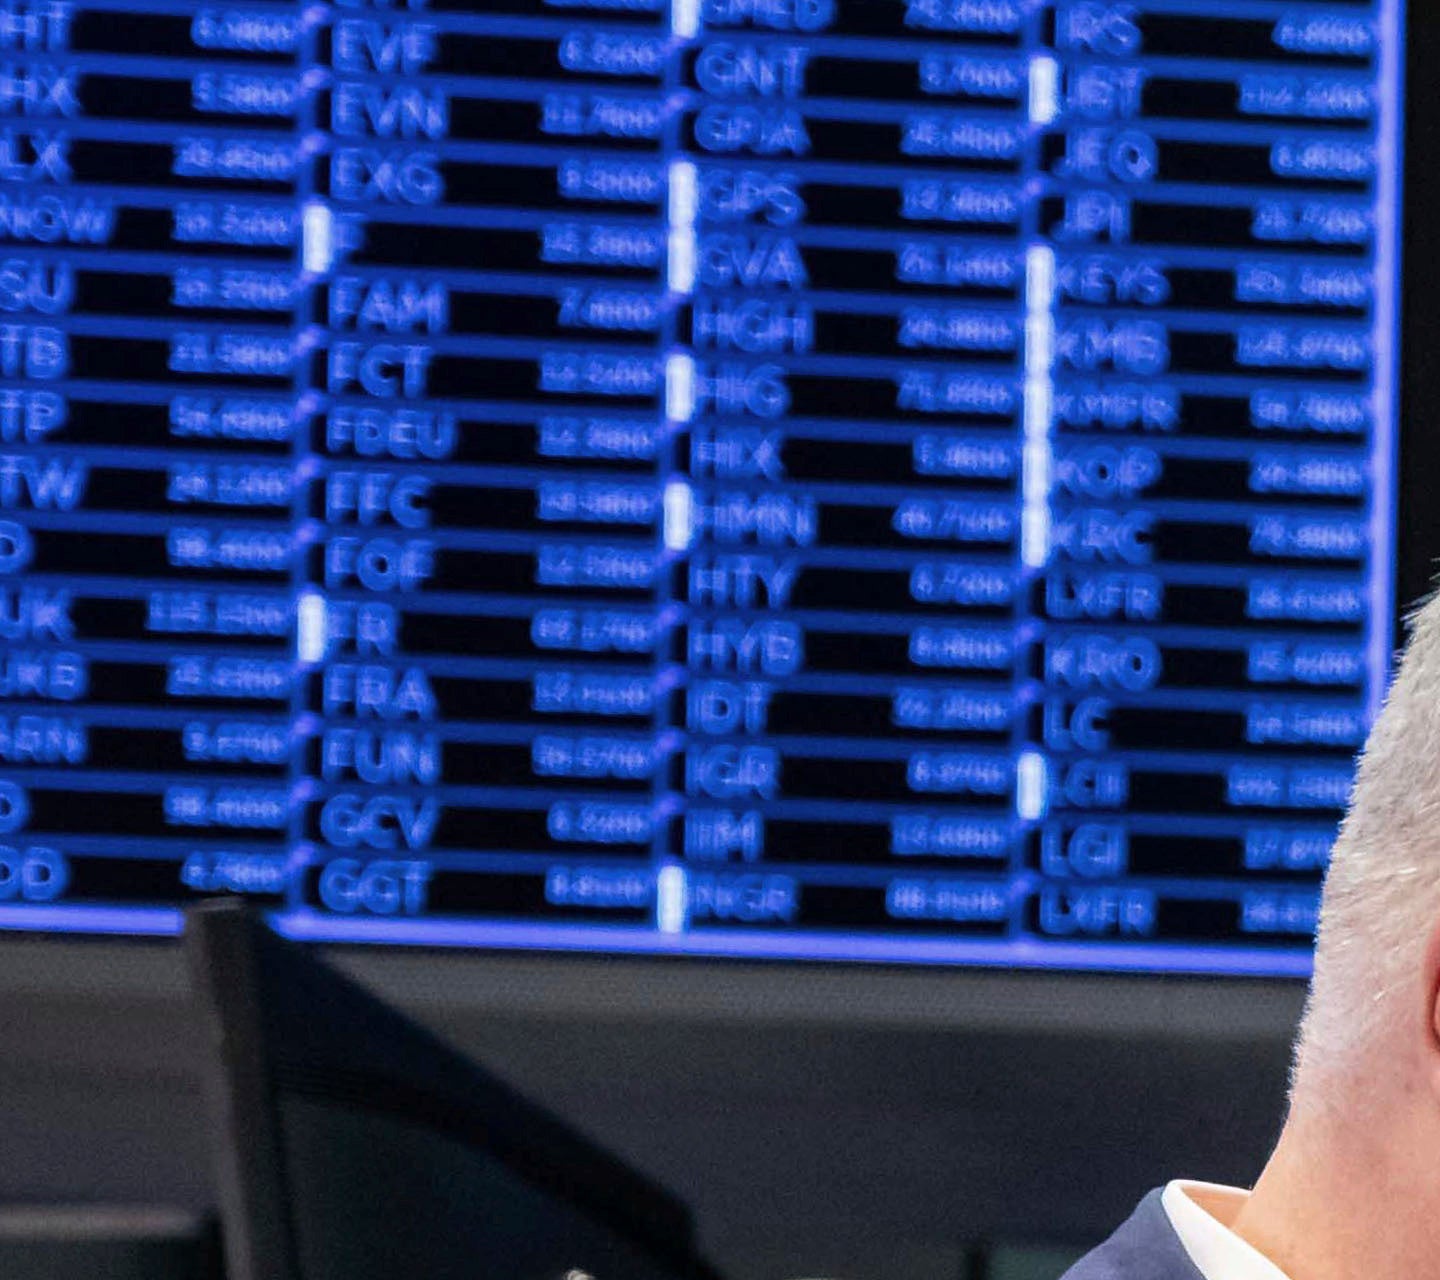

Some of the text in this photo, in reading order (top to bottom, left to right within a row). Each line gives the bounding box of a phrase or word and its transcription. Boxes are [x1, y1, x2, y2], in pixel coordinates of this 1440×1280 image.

[327, 277, 450, 333] FAM
[327, 343, 434, 399] FCT
[326, 472, 434, 529] FFC
[325, 537, 437, 593] FOF
[327, 600, 399, 656] FR
[322, 663, 437, 720] FRA
[1043, 697, 1111, 750] LC
[322, 729, 442, 785] FUN
[320, 793, 438, 850] GCV
[318, 859, 434, 914] GGT
